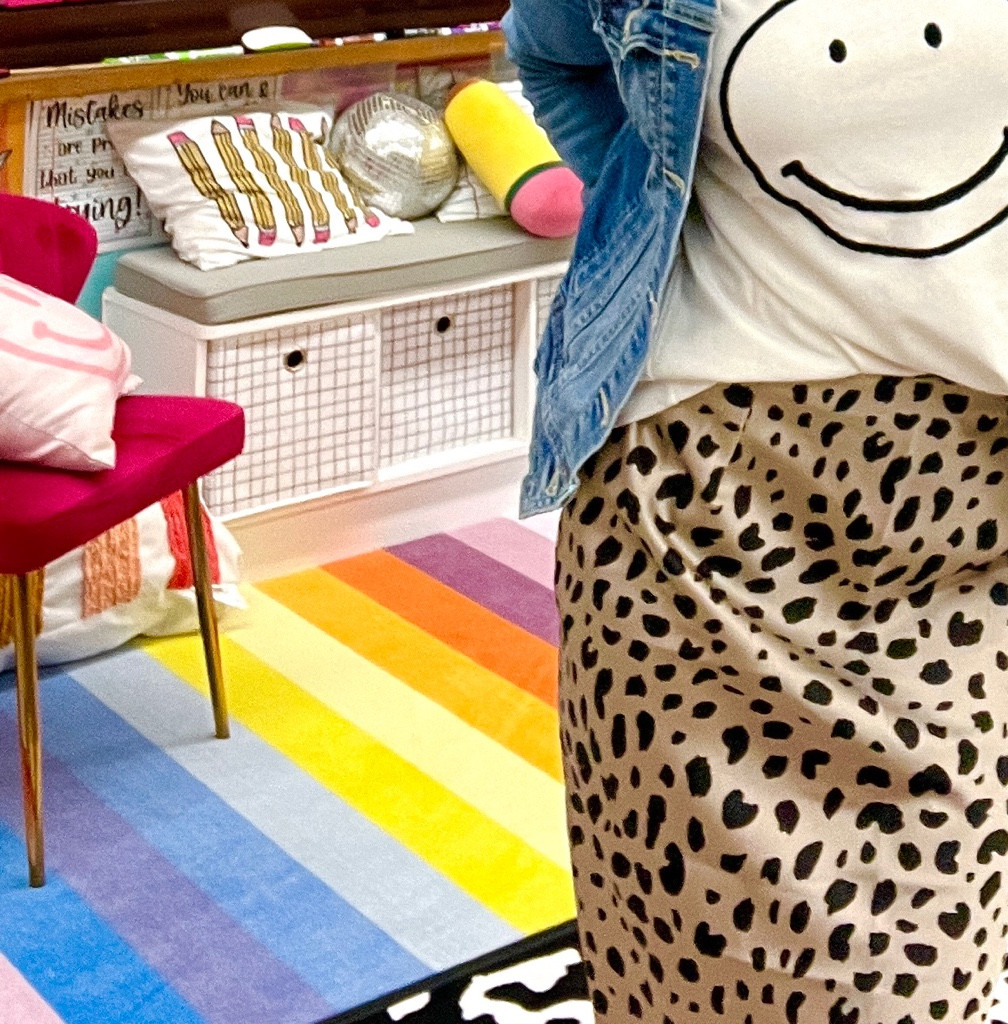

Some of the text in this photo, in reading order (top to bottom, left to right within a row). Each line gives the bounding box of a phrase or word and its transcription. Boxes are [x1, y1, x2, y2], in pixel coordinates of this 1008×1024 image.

[176, 81, 211, 106] You
[45, 92, 144, 129] Mistakes
[40, 166, 115, 190] that you
